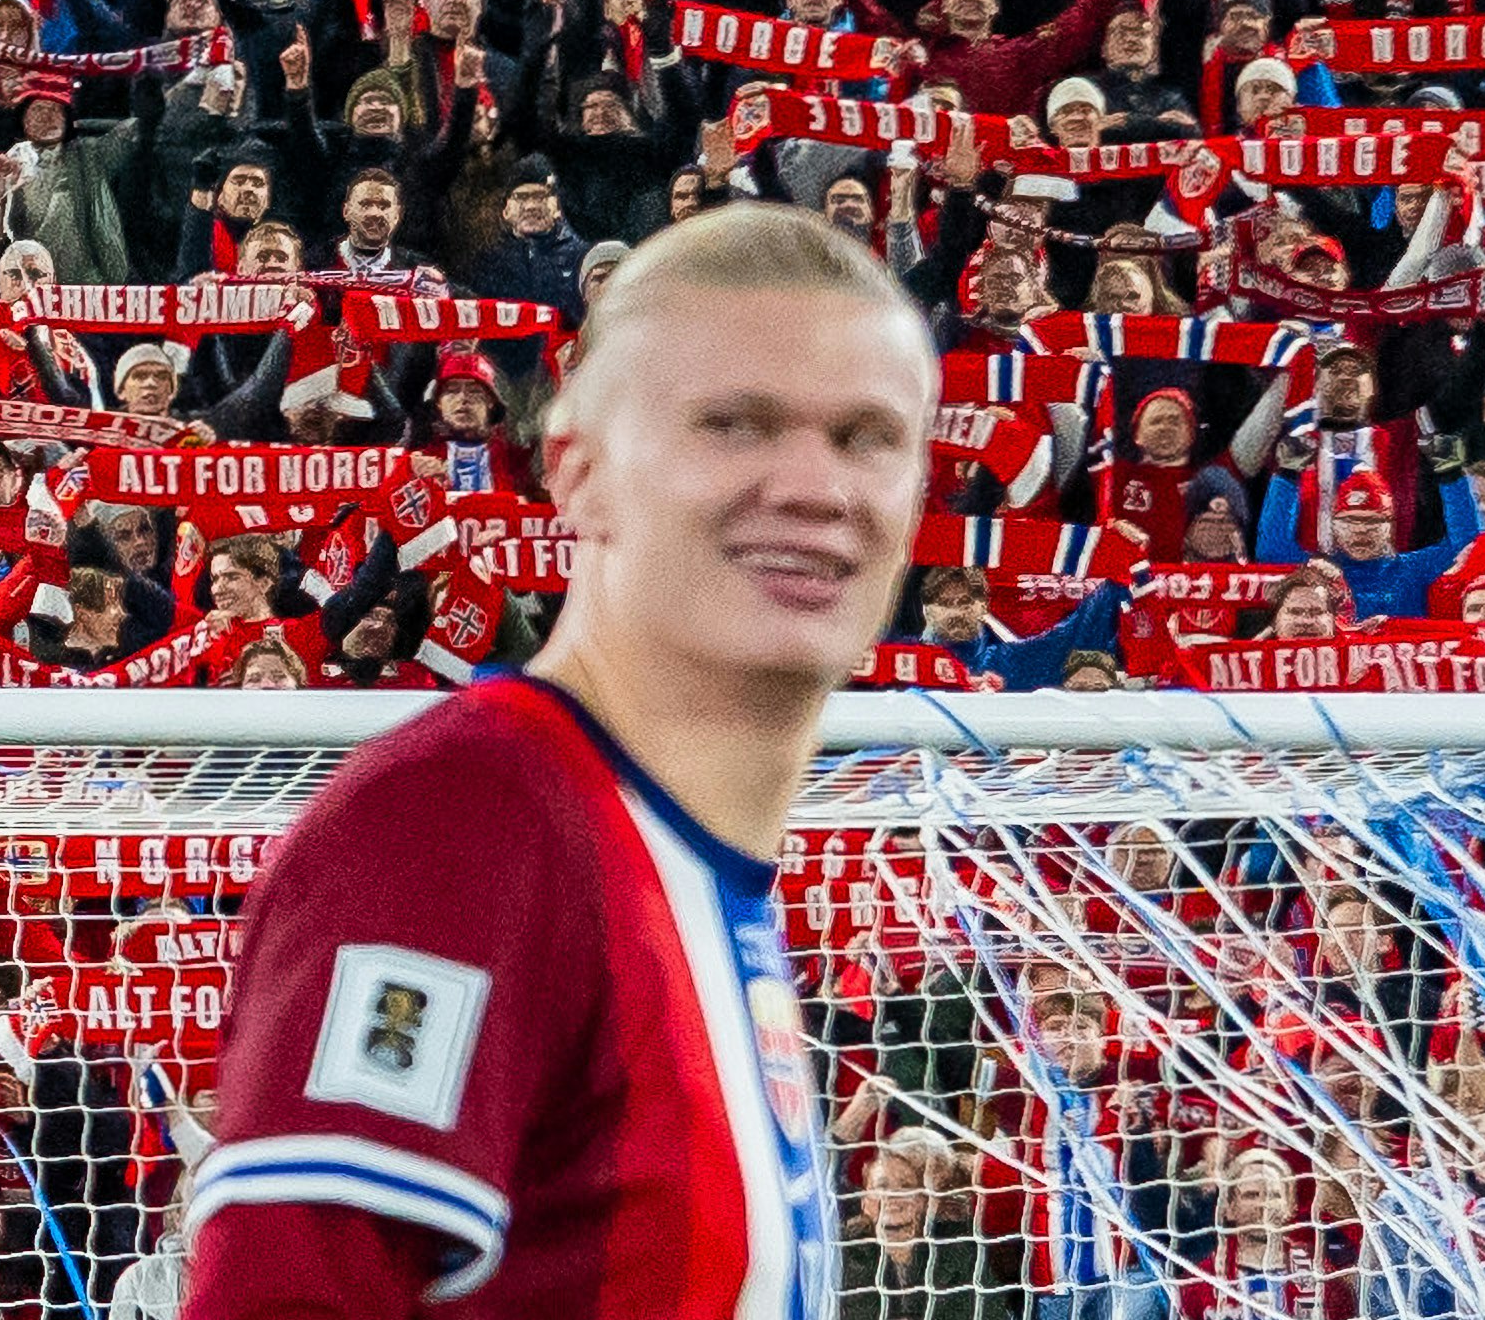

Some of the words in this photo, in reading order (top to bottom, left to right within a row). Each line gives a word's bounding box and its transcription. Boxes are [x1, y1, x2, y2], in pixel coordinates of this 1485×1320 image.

[682, 7, 834, 69] NORGE
[118, 453, 183, 495] ALT
[195, 452, 264, 495] FOR
[532, 539, 574, 579] FO
[1209, 650, 1264, 689] ALT
[1275, 646, 1339, 689] FOR
[97, 837, 254, 883] NORG
[87, 985, 158, 1030] ALT
[173, 985, 224, 1029] FO
